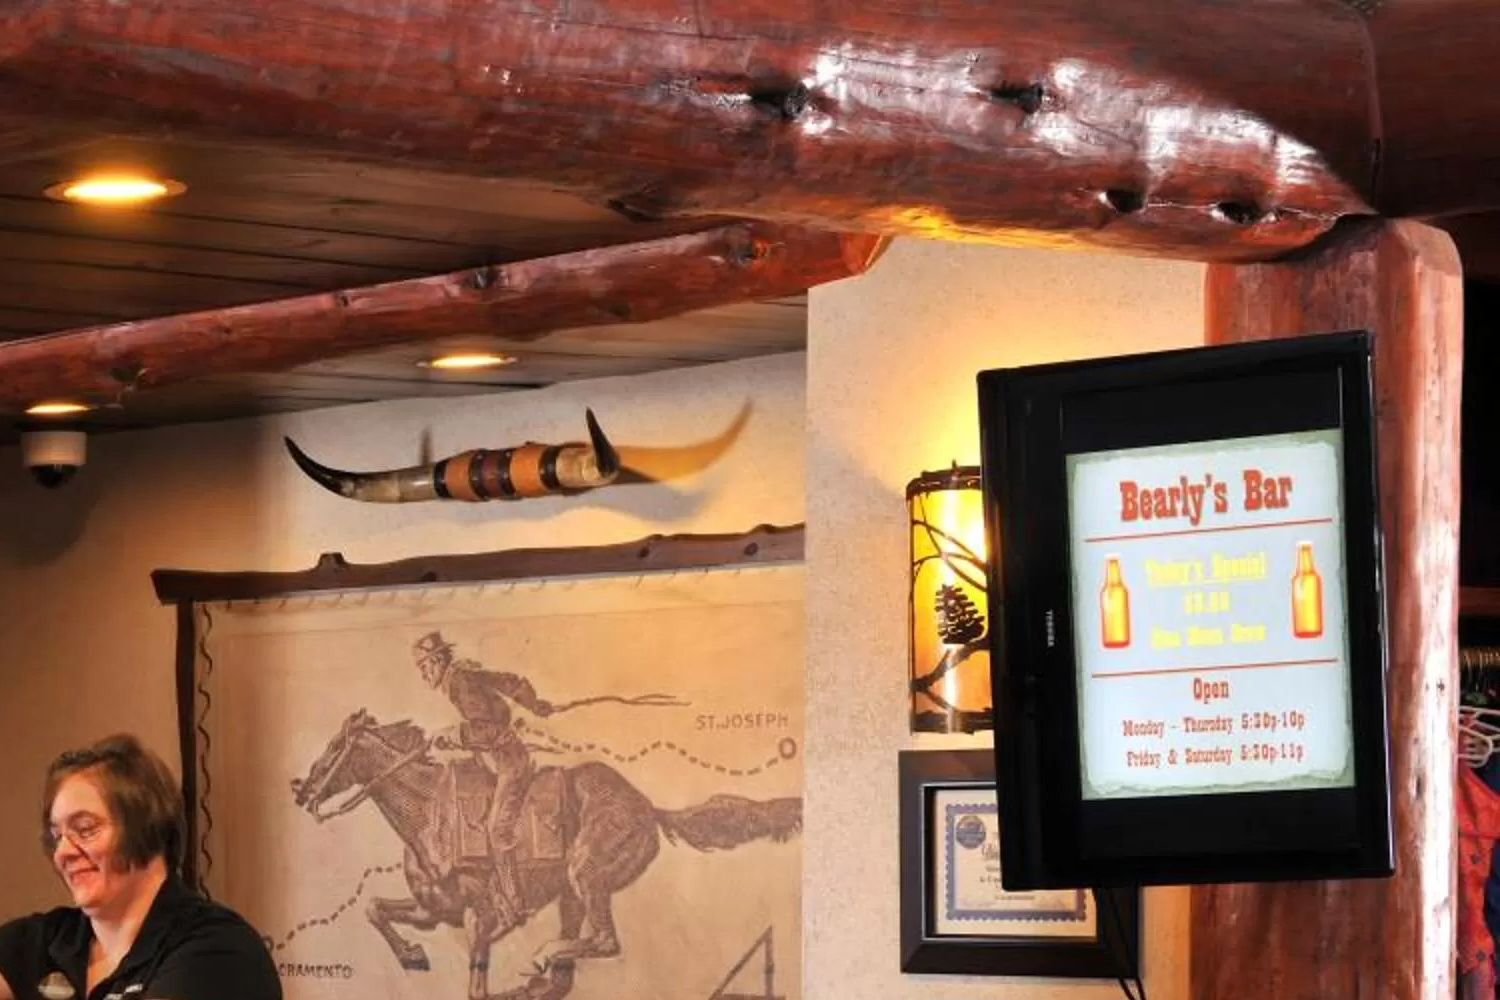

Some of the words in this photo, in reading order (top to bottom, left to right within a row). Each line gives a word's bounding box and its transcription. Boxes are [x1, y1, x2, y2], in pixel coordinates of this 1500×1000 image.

[1119, 474, 1228, 526] Bearly's
[1243, 469, 1293, 511] Bar
[1192, 677, 1230, 704] Open
[1122, 719, 1165, 739] Monday
[1183, 715, 1234, 735] Thursday
[1126, 748, 1162, 769] Friday
[1167, 747, 1178, 765] &
[1184, 745, 1233, 766] Saturday
